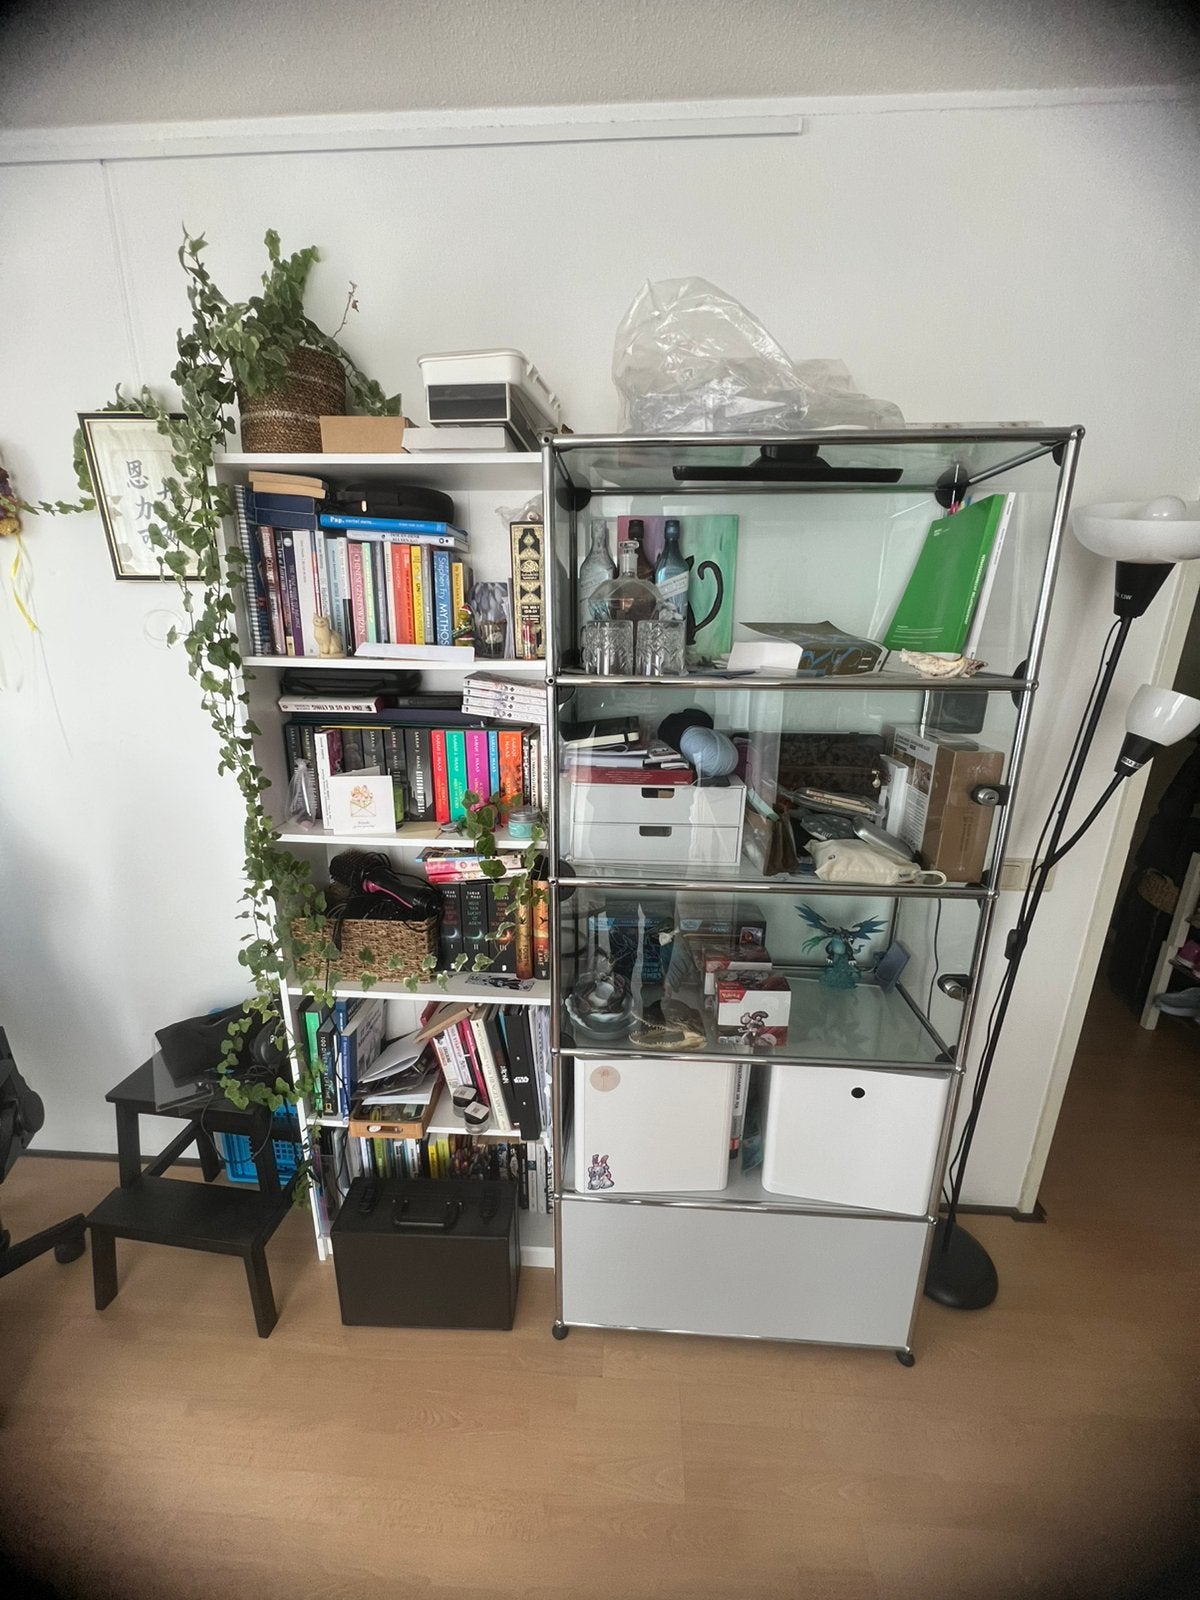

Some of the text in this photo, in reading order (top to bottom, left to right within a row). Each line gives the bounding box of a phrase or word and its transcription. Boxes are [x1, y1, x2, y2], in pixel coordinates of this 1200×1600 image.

[354, 553, 363, 582] CHINESE
[437, 556, 448, 644] Stephen Fry MYTHOS
